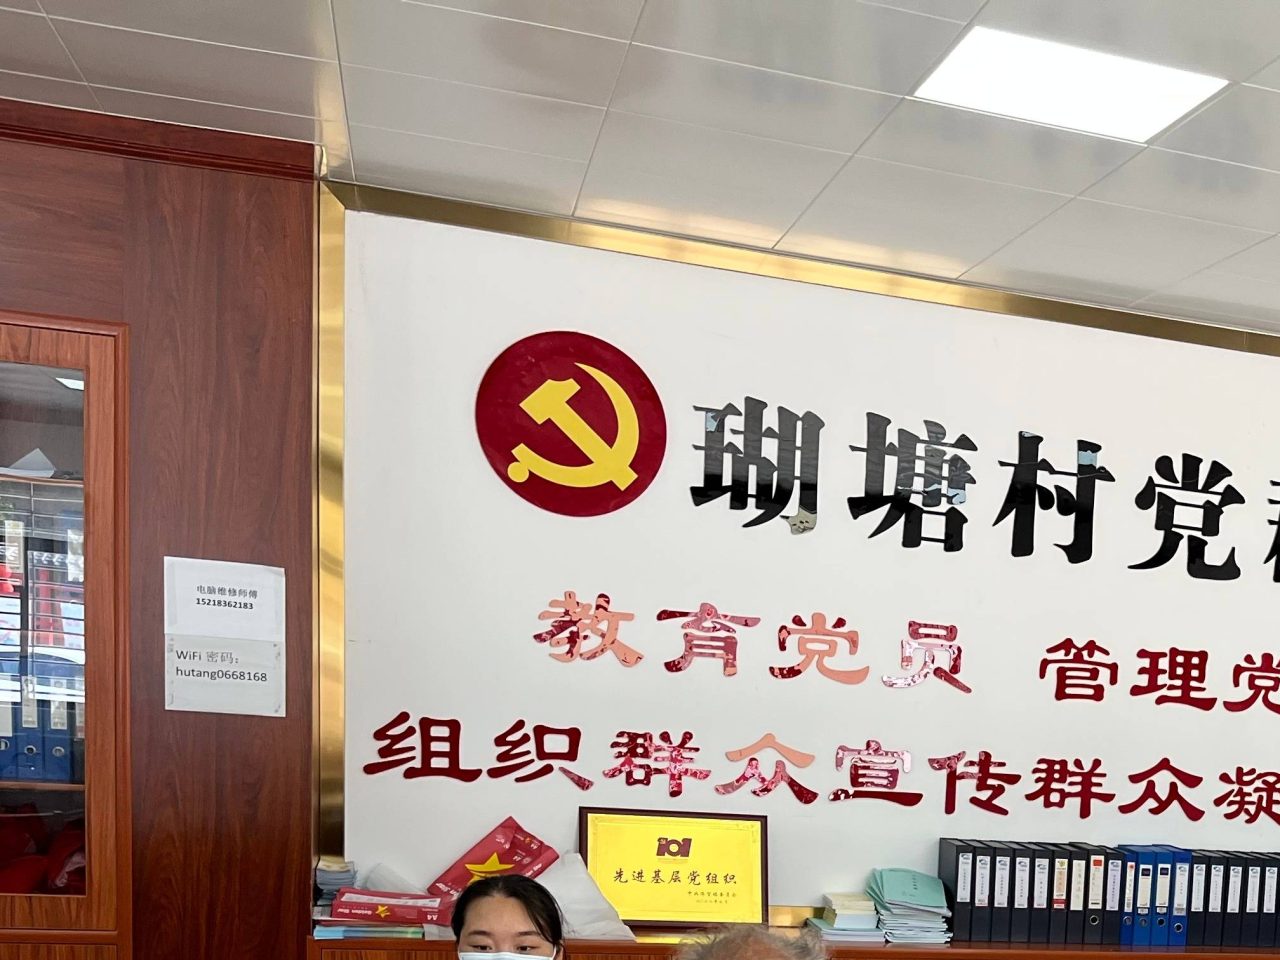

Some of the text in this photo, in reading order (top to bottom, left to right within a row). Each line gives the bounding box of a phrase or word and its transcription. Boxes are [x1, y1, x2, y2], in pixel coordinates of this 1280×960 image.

[196, 585, 258, 599] 电脑维修师傅
[196, 598, 254, 610] 15218362183
[533, 591, 972, 694] 教育党员
[176, 650, 202, 661] WiFi
[176, 667, 268, 682] hutang0668168
[613, 868, 737, 885] 先进基层党组织
